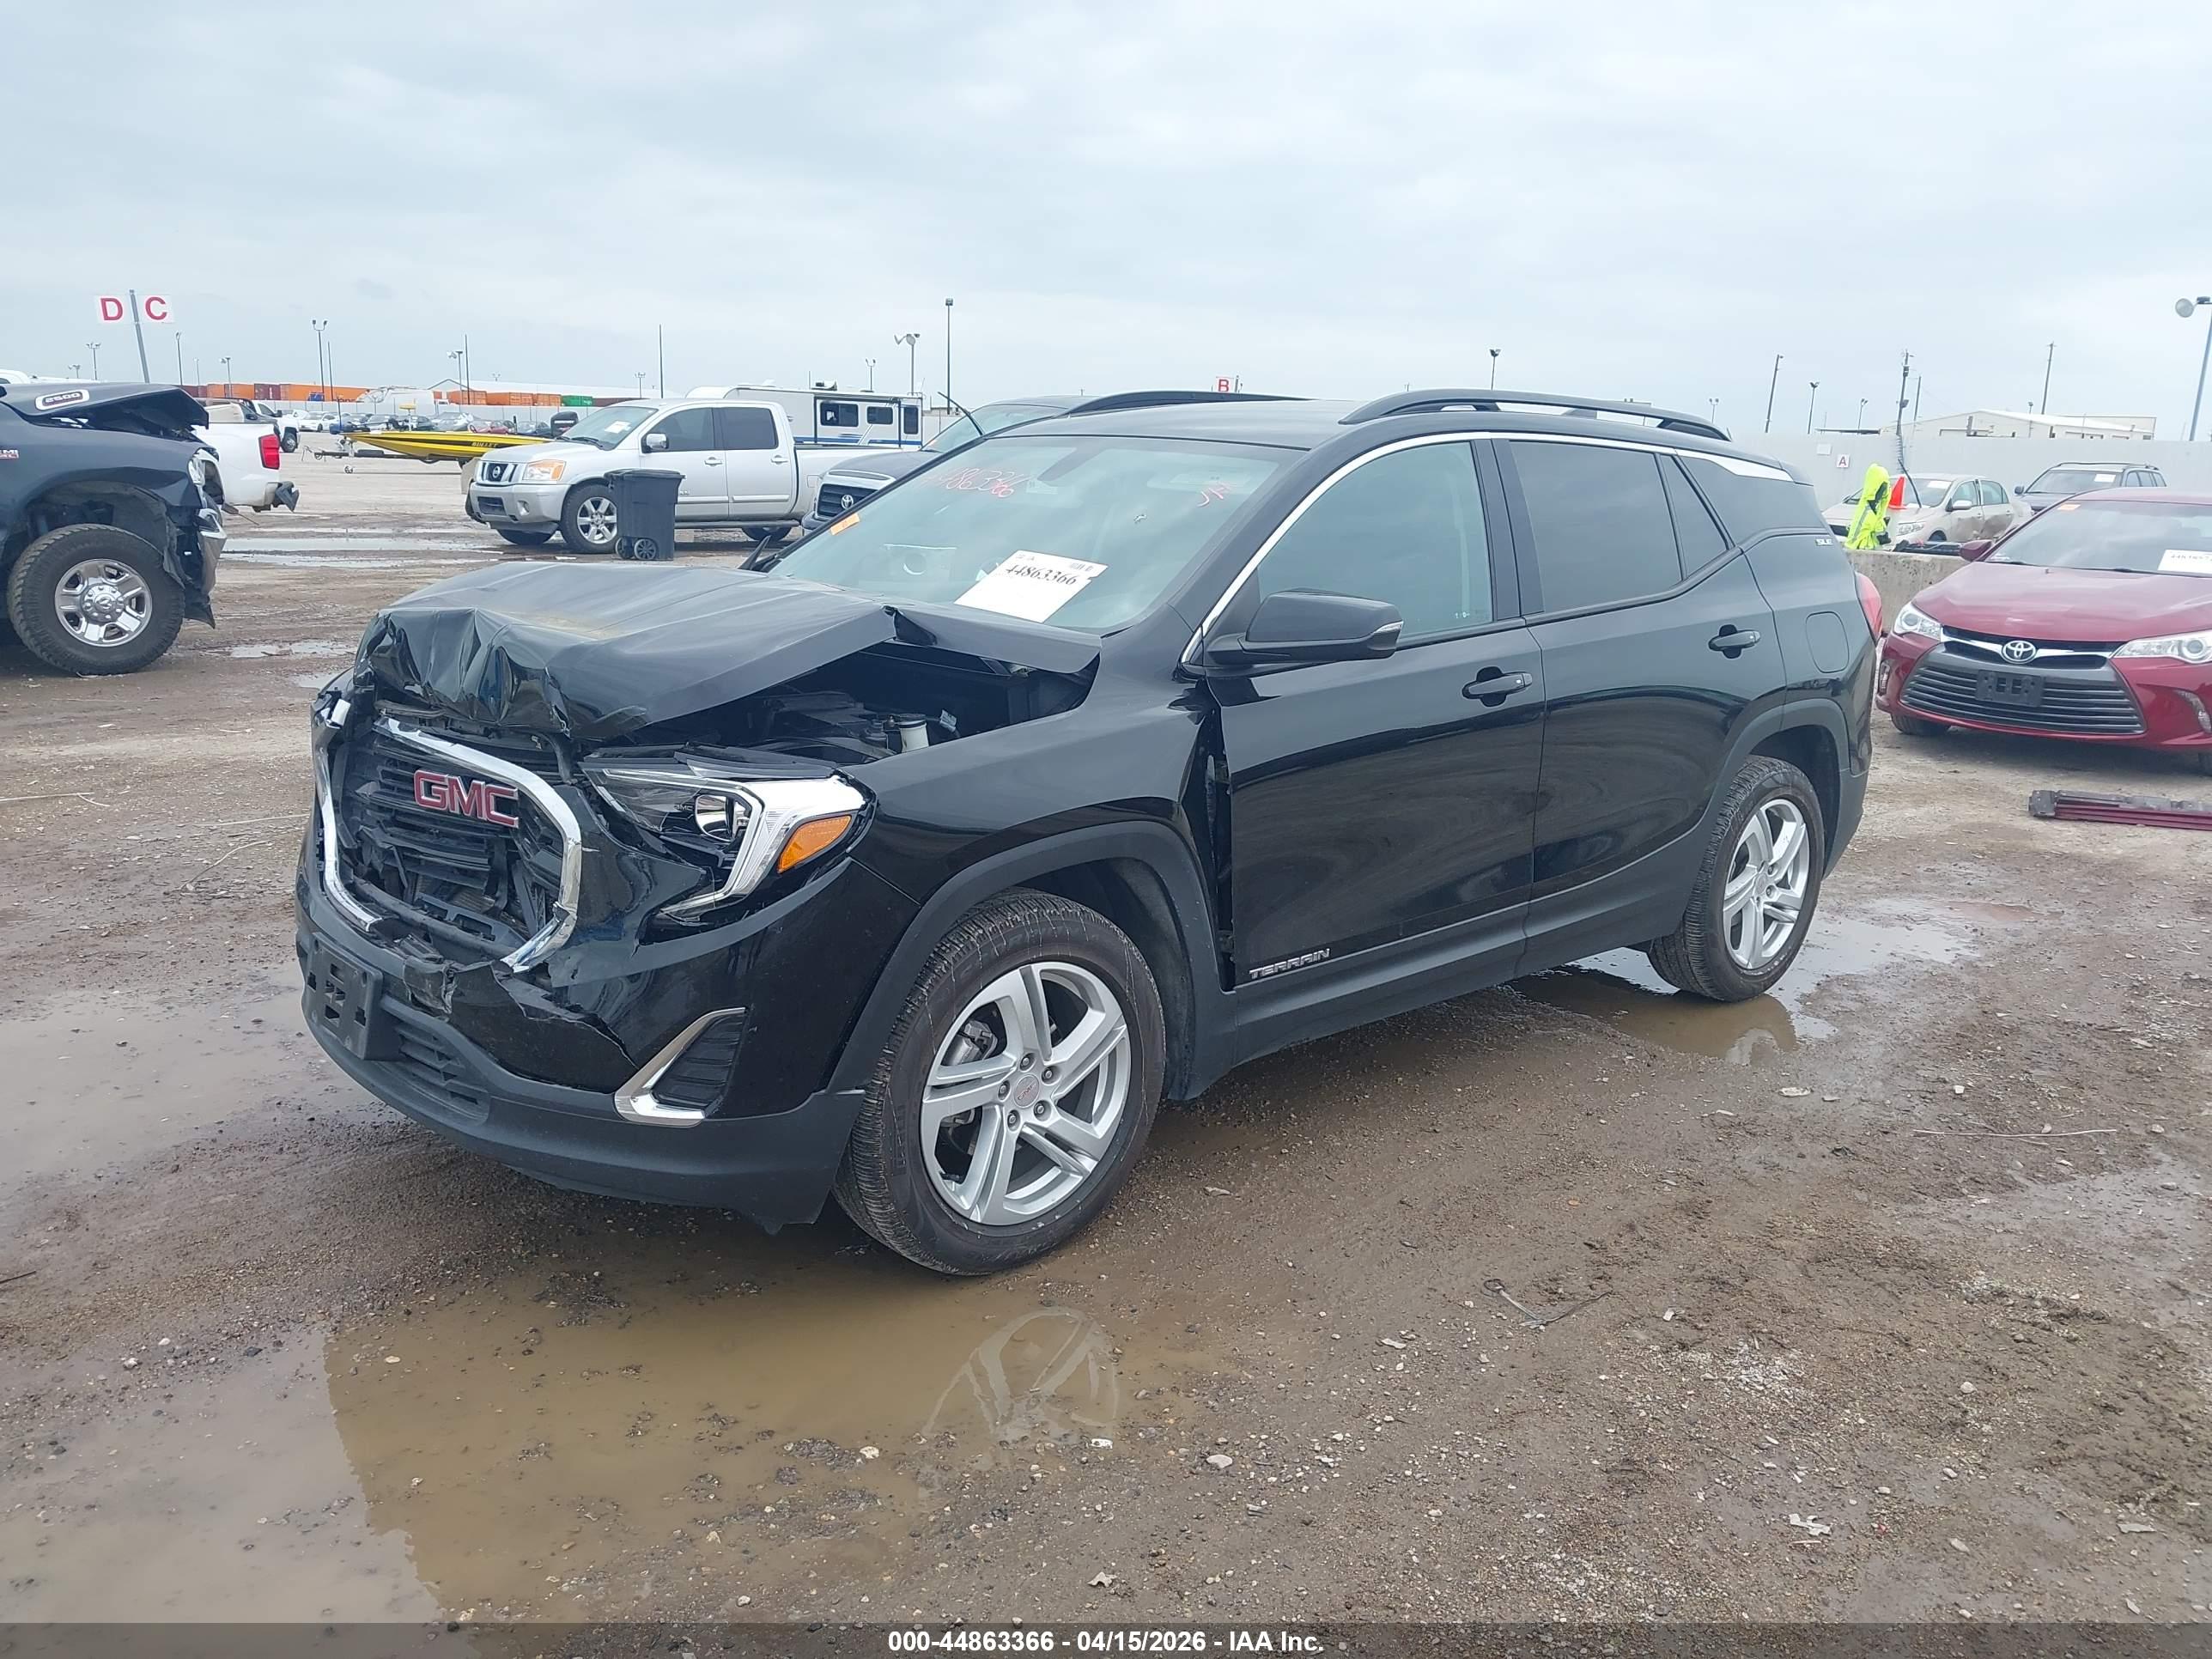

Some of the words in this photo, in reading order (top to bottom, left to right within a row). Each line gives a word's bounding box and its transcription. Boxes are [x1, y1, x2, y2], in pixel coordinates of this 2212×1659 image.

[100, 297, 124, 320] D
[145, 296, 167, 320] C
[1218, 379, 1229, 392] B
[45, 392, 81, 404] 2500
[1838, 456, 1847, 466] A
[1005, 563, 1079, 586] 44863366
[414, 769, 519, 829] GMC
[1249, 947, 1331, 980] TERRAIN
